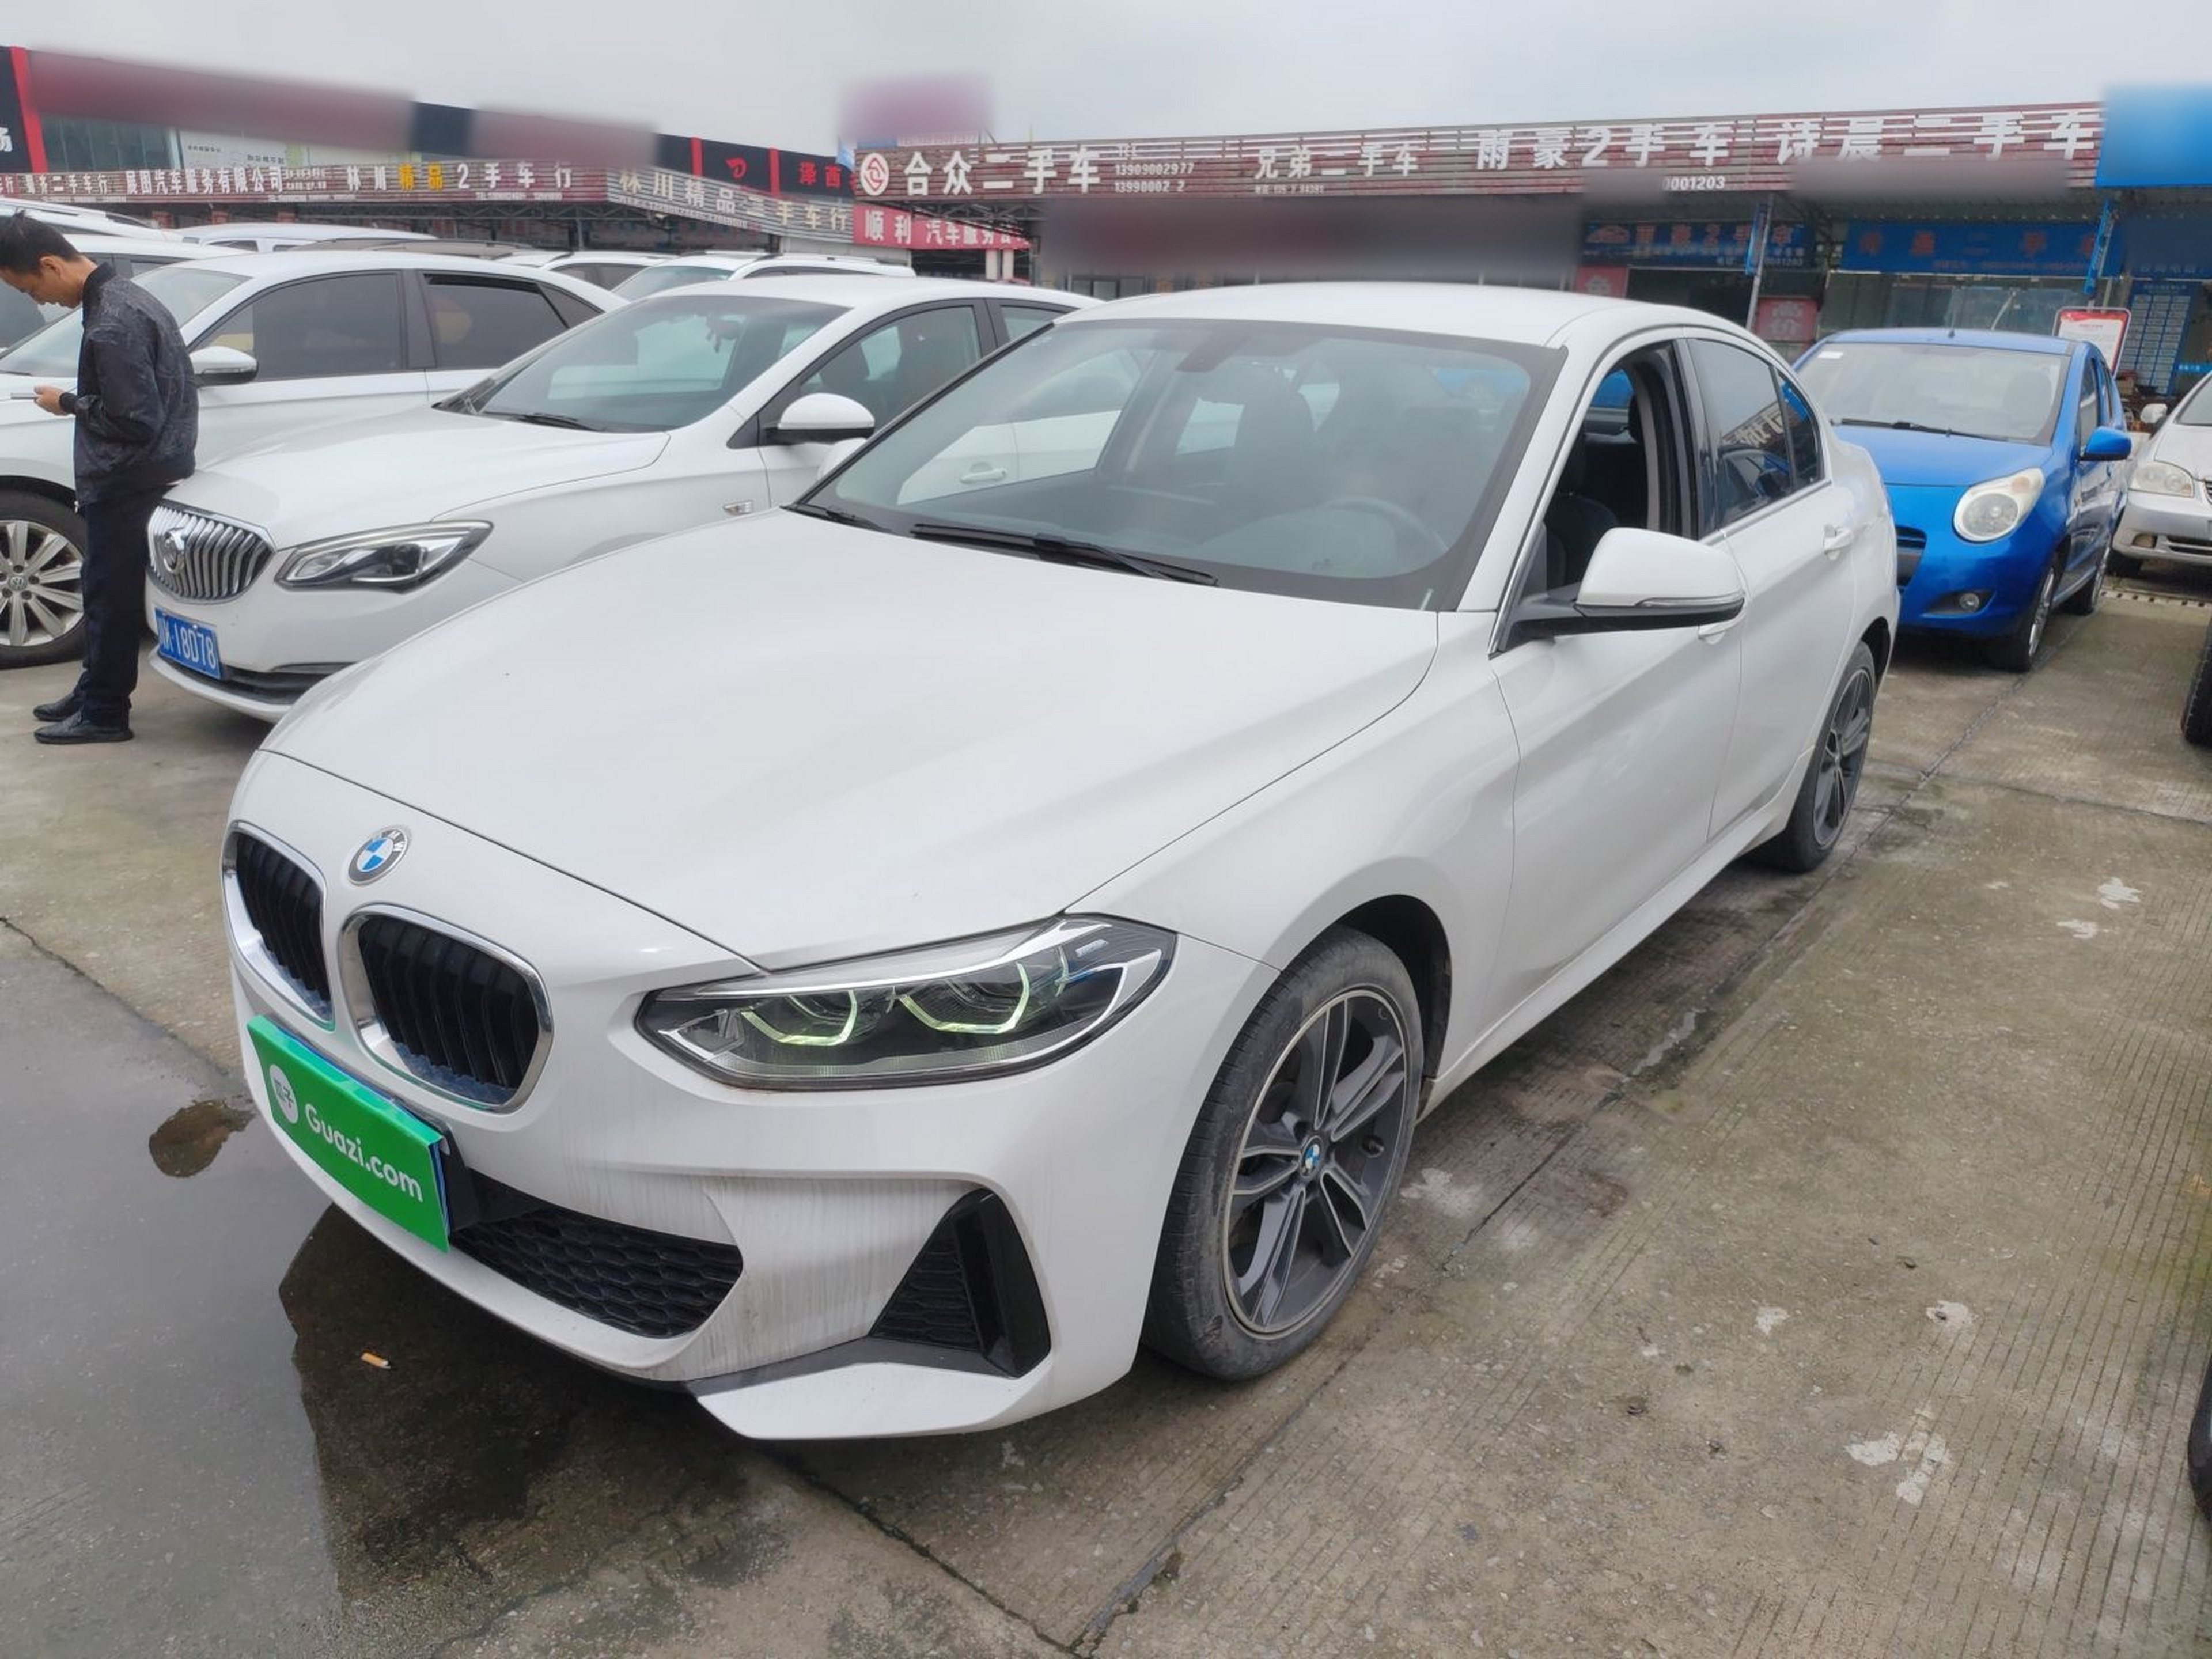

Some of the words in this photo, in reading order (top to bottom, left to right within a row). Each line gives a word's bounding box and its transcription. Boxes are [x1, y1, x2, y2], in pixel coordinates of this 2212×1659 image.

[903, 146, 1101, 196] 合众二手车
[1255, 144, 1419, 179] 兄弟二手车
[305, 1103, 423, 1203] Guazi.com
